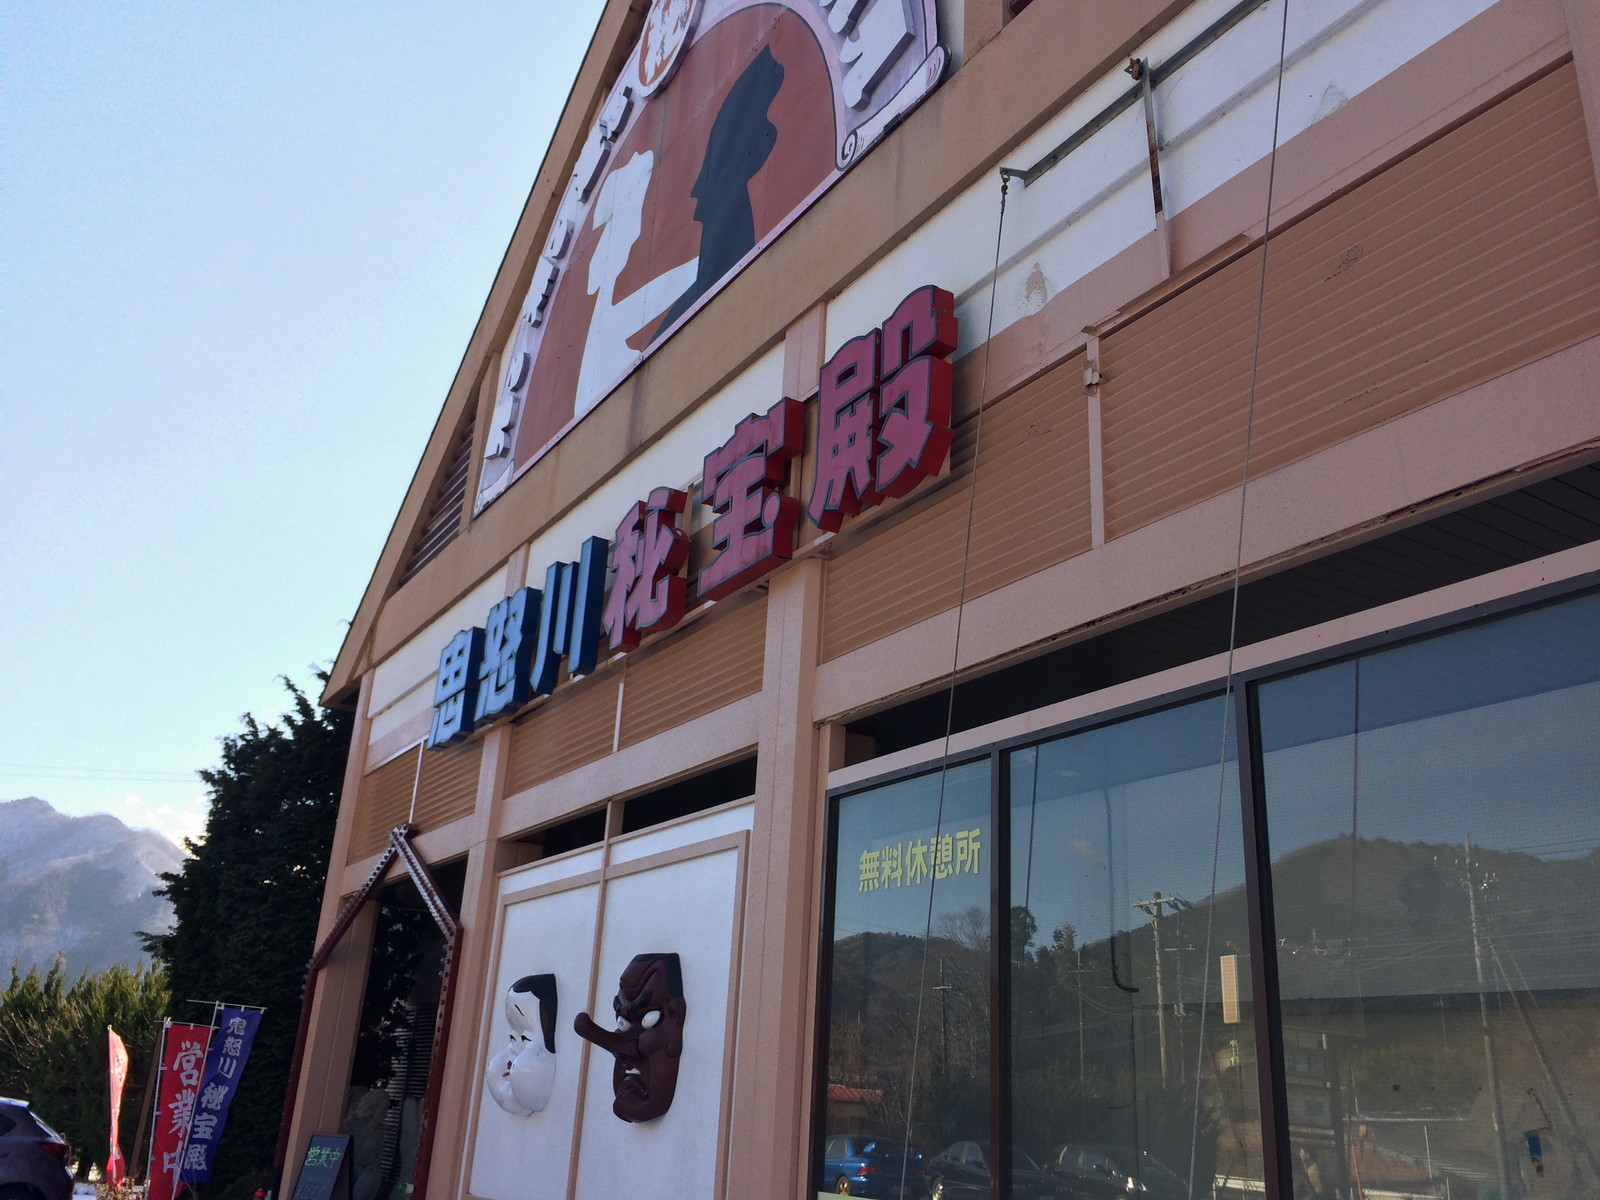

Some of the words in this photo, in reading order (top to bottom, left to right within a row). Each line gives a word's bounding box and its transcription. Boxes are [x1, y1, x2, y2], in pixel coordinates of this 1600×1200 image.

[859, 828, 981, 892] 無料休憩所
[162, 1040, 204, 1191] 営業中
